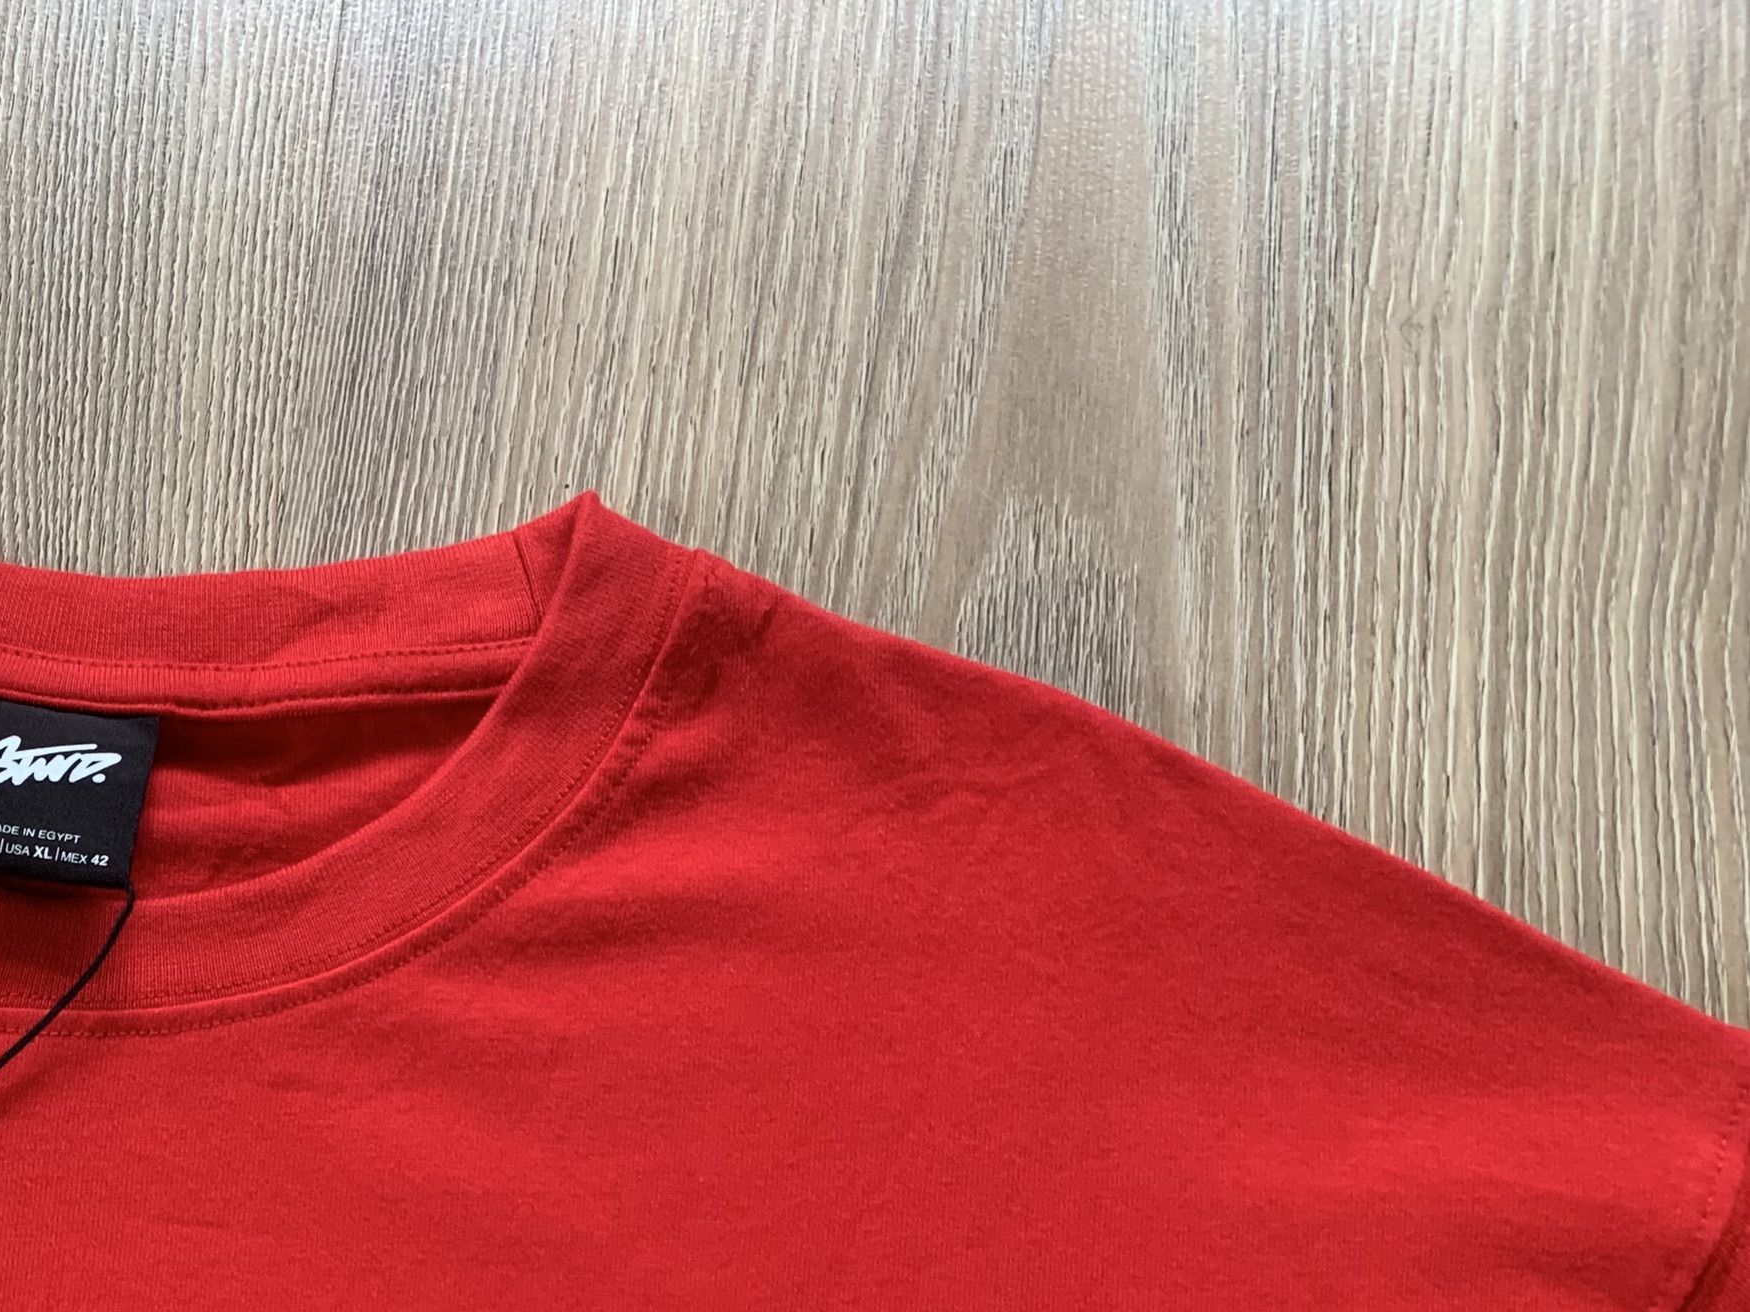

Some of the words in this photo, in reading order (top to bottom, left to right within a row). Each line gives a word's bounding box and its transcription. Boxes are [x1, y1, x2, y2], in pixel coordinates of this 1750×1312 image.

[23, 827, 34, 838] IN
[38, 829, 81, 844] EGYPT
[91, 854, 109, 867] 42
